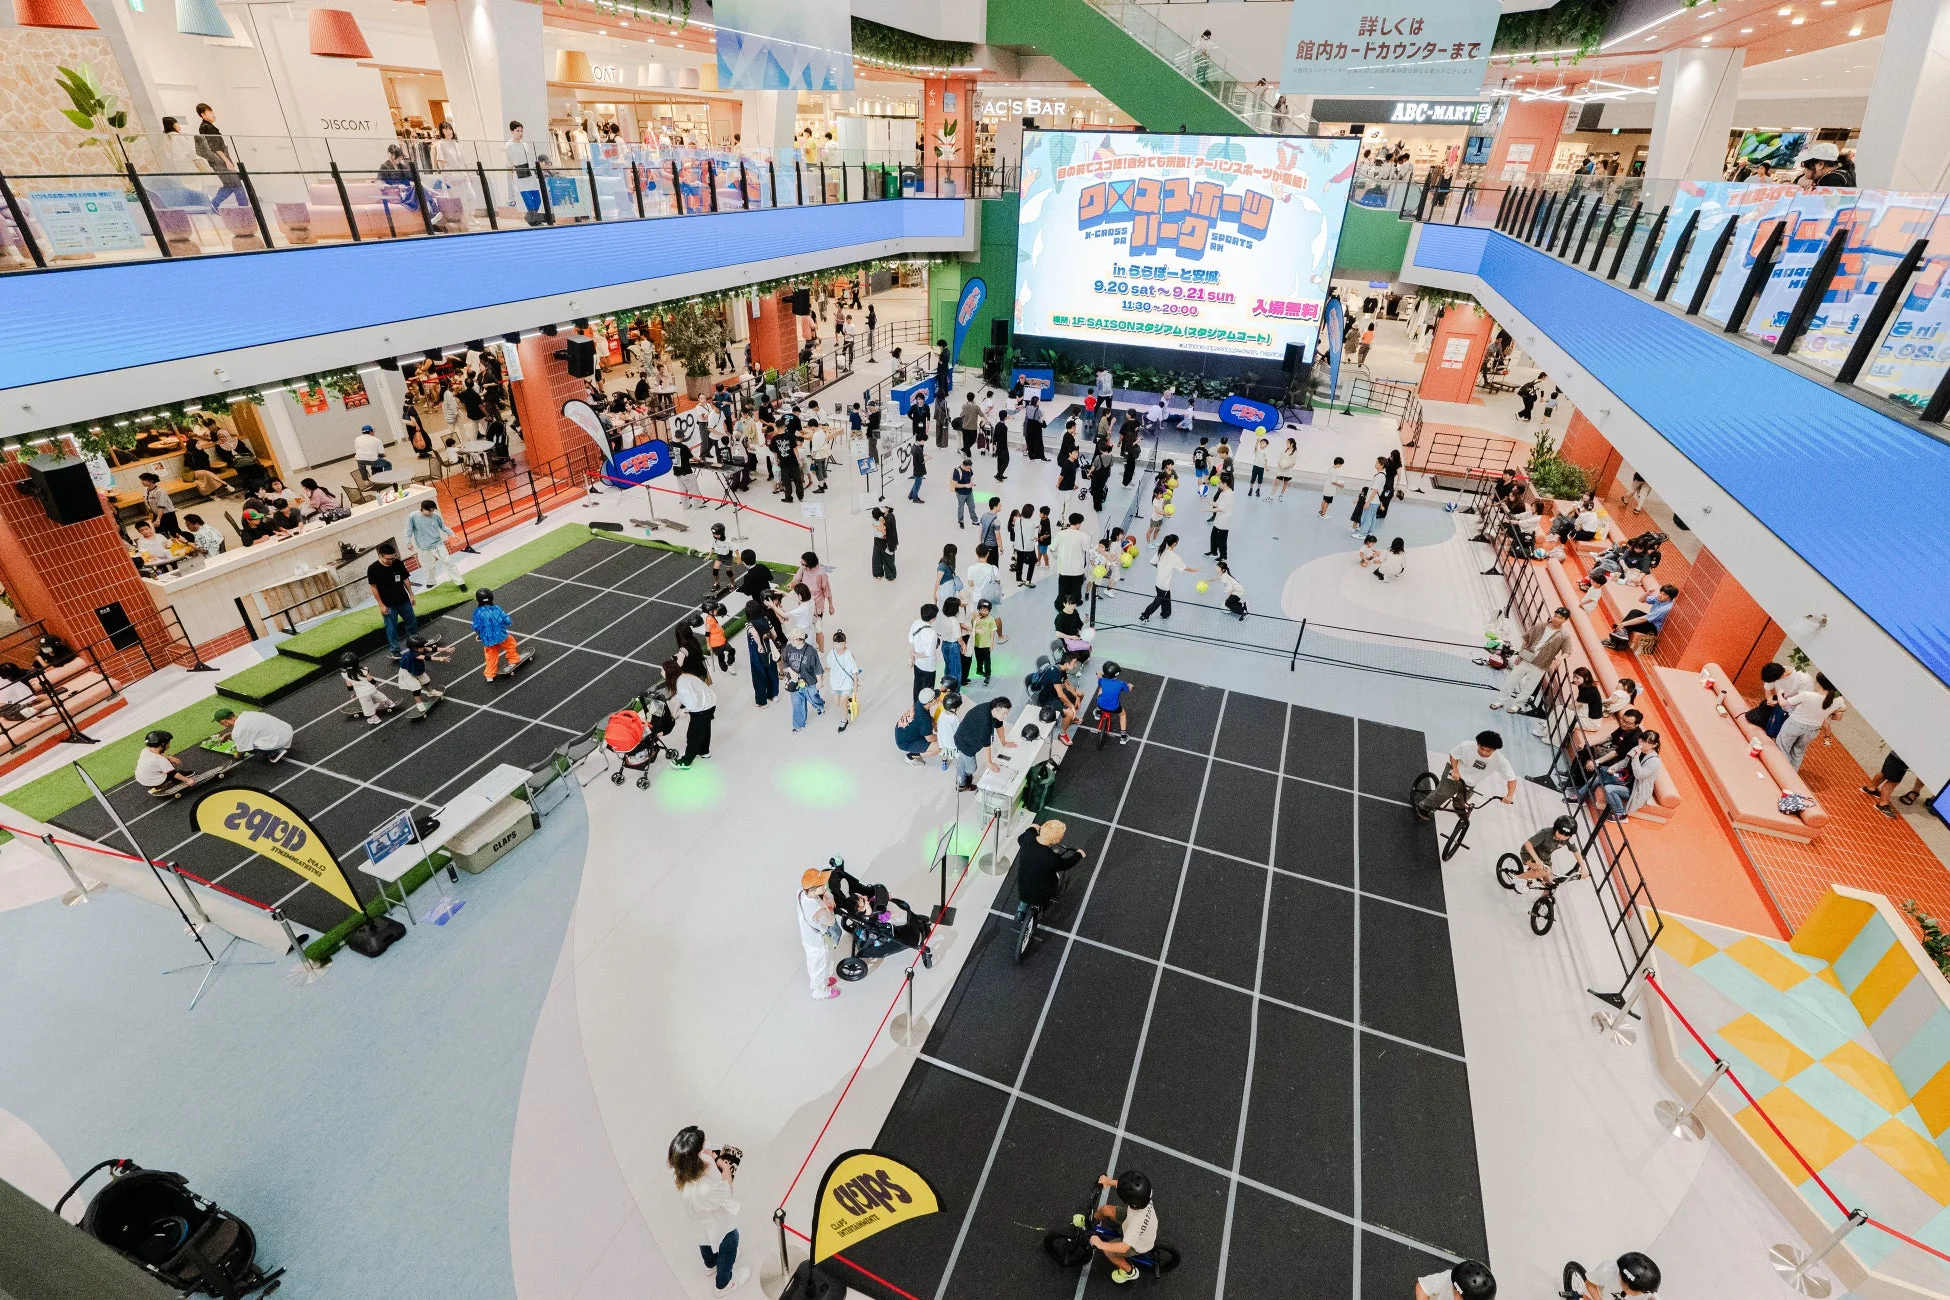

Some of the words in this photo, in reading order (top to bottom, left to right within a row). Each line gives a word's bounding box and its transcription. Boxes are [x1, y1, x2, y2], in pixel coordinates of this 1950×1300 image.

[1358, 16, 1425, 36] 詳しくは
[1295, 40, 1482, 61] 館内カードカウンターまで
[983, 98, 1023, 115] AC'S
[1026, 97, 1067, 115] BAR
[1391, 102, 1475, 122] ABC-MART
[321, 118, 370, 131] DISCOAT
[1211, 232, 1253, 250] SPORTS
[1113, 262, 1126, 277] in
[1128, 264, 1220, 285] ららぽーと安城
[1094, 279, 1129, 294] 9.20
[1131, 284, 1156, 296] sat
[1172, 286, 1205, 301] 9.21
[1207, 291, 1236, 304] sun
[1252, 298, 1320, 320] 入場無料
[1072, 316, 1085, 326] 1F
[492, 830, 517, 852] CLAPS
